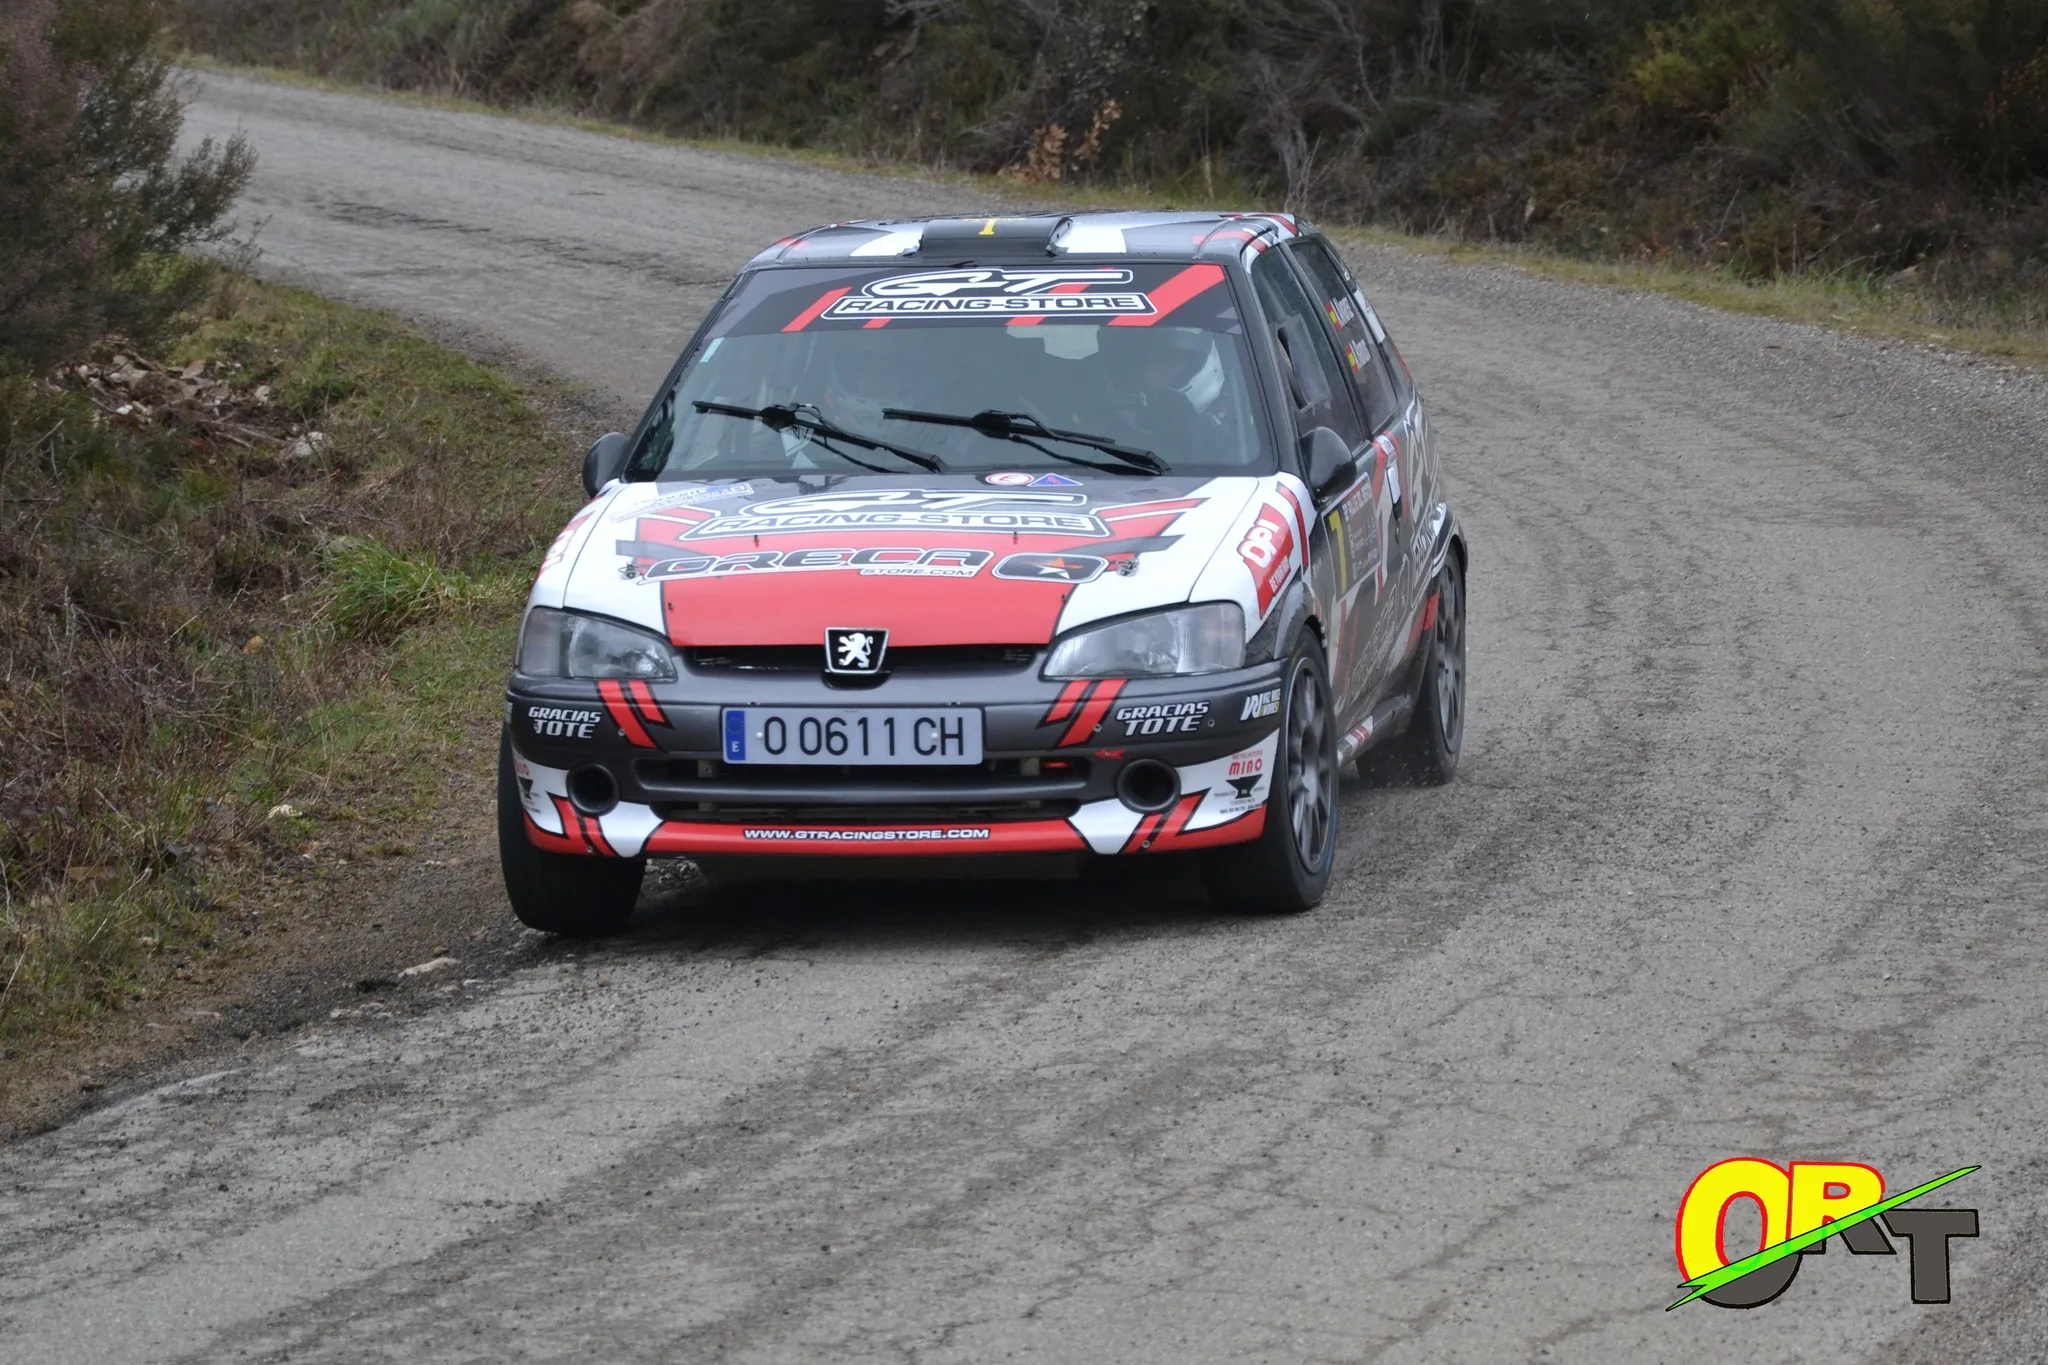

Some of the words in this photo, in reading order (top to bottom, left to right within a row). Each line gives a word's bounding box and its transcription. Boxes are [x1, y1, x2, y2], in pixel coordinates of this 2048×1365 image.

[840, 298, 1140, 312] RACING-STORE
[706, 513, 1091, 534] RACING-STORE
[1240, 518, 1280, 568] DPI
[643, 549, 991, 580] ORECA
[862, 567, 974, 577] STORE.COM
[528, 706, 602, 723] GRACIAS
[1116, 701, 1211, 721] GRACIAS
[533, 719, 595, 739] TOTE
[1125, 714, 1204, 737] TOTE
[800, 716, 895, 756] 0611
[914, 717, 964, 756] CH
[743, 828, 991, 841] WWW.GTRACINGSTORE.COM
